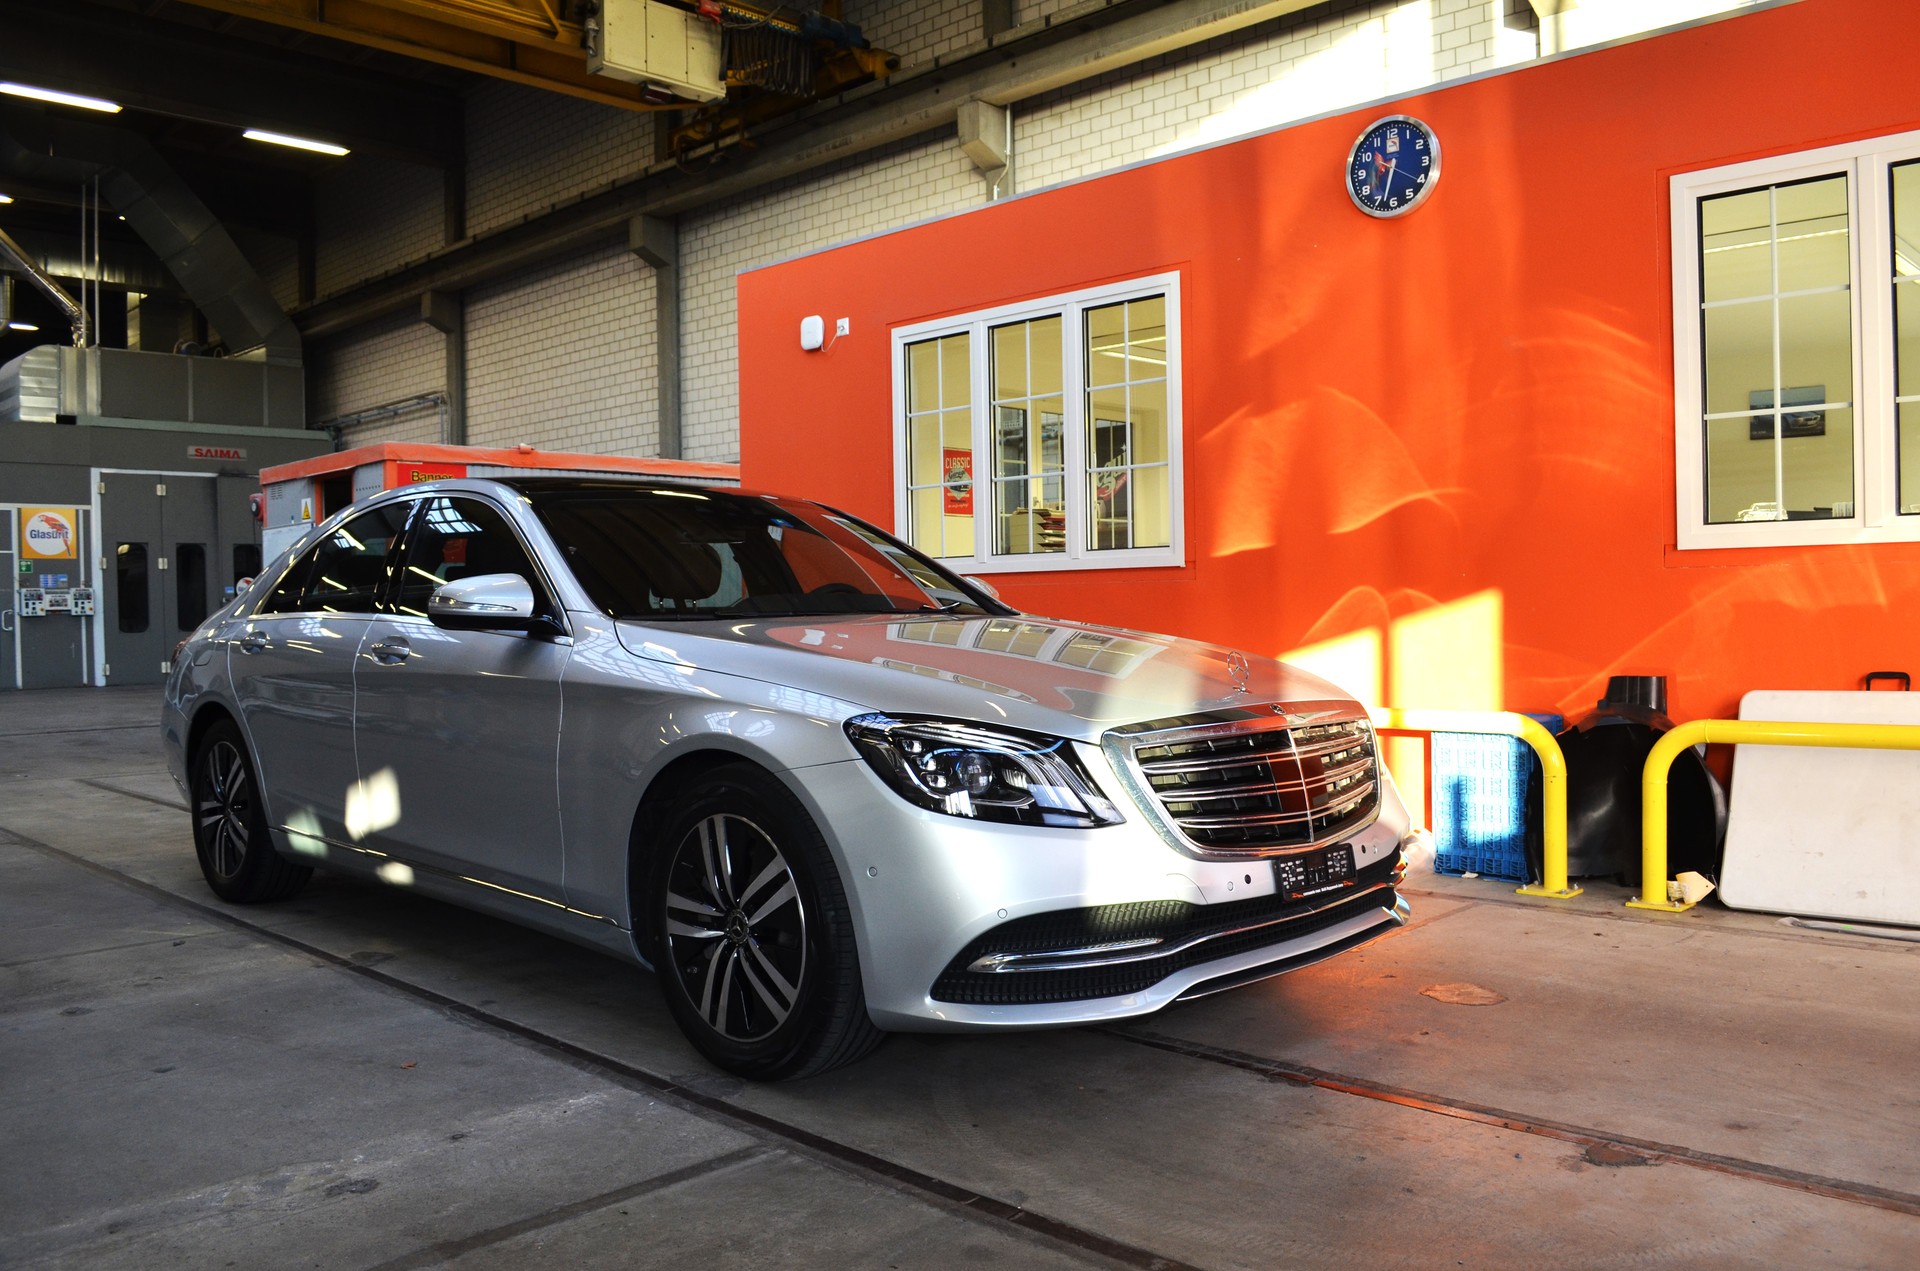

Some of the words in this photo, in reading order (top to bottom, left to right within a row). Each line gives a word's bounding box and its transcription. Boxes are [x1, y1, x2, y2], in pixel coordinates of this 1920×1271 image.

[1387, 128, 1398, 139] 12
[1406, 129, 1410, 139] 1
[1374, 137, 1381, 147] 11
[1416, 139, 1424, 150] 2
[1362, 152, 1372, 163] 10
[1422, 156, 1429, 166] 3
[1358, 170, 1366, 180] 9
[1417, 174, 1426, 183] 4
[1362, 185, 1371, 195] 8
[1405, 188, 1414, 199] 5
[1374, 195, 1382, 206] 7
[1389, 197, 1398, 207] 6
[195, 448, 241, 459] SAIMA
[946, 457, 970, 468] CLASSIC
[30, 530, 69, 539] Glasurit
